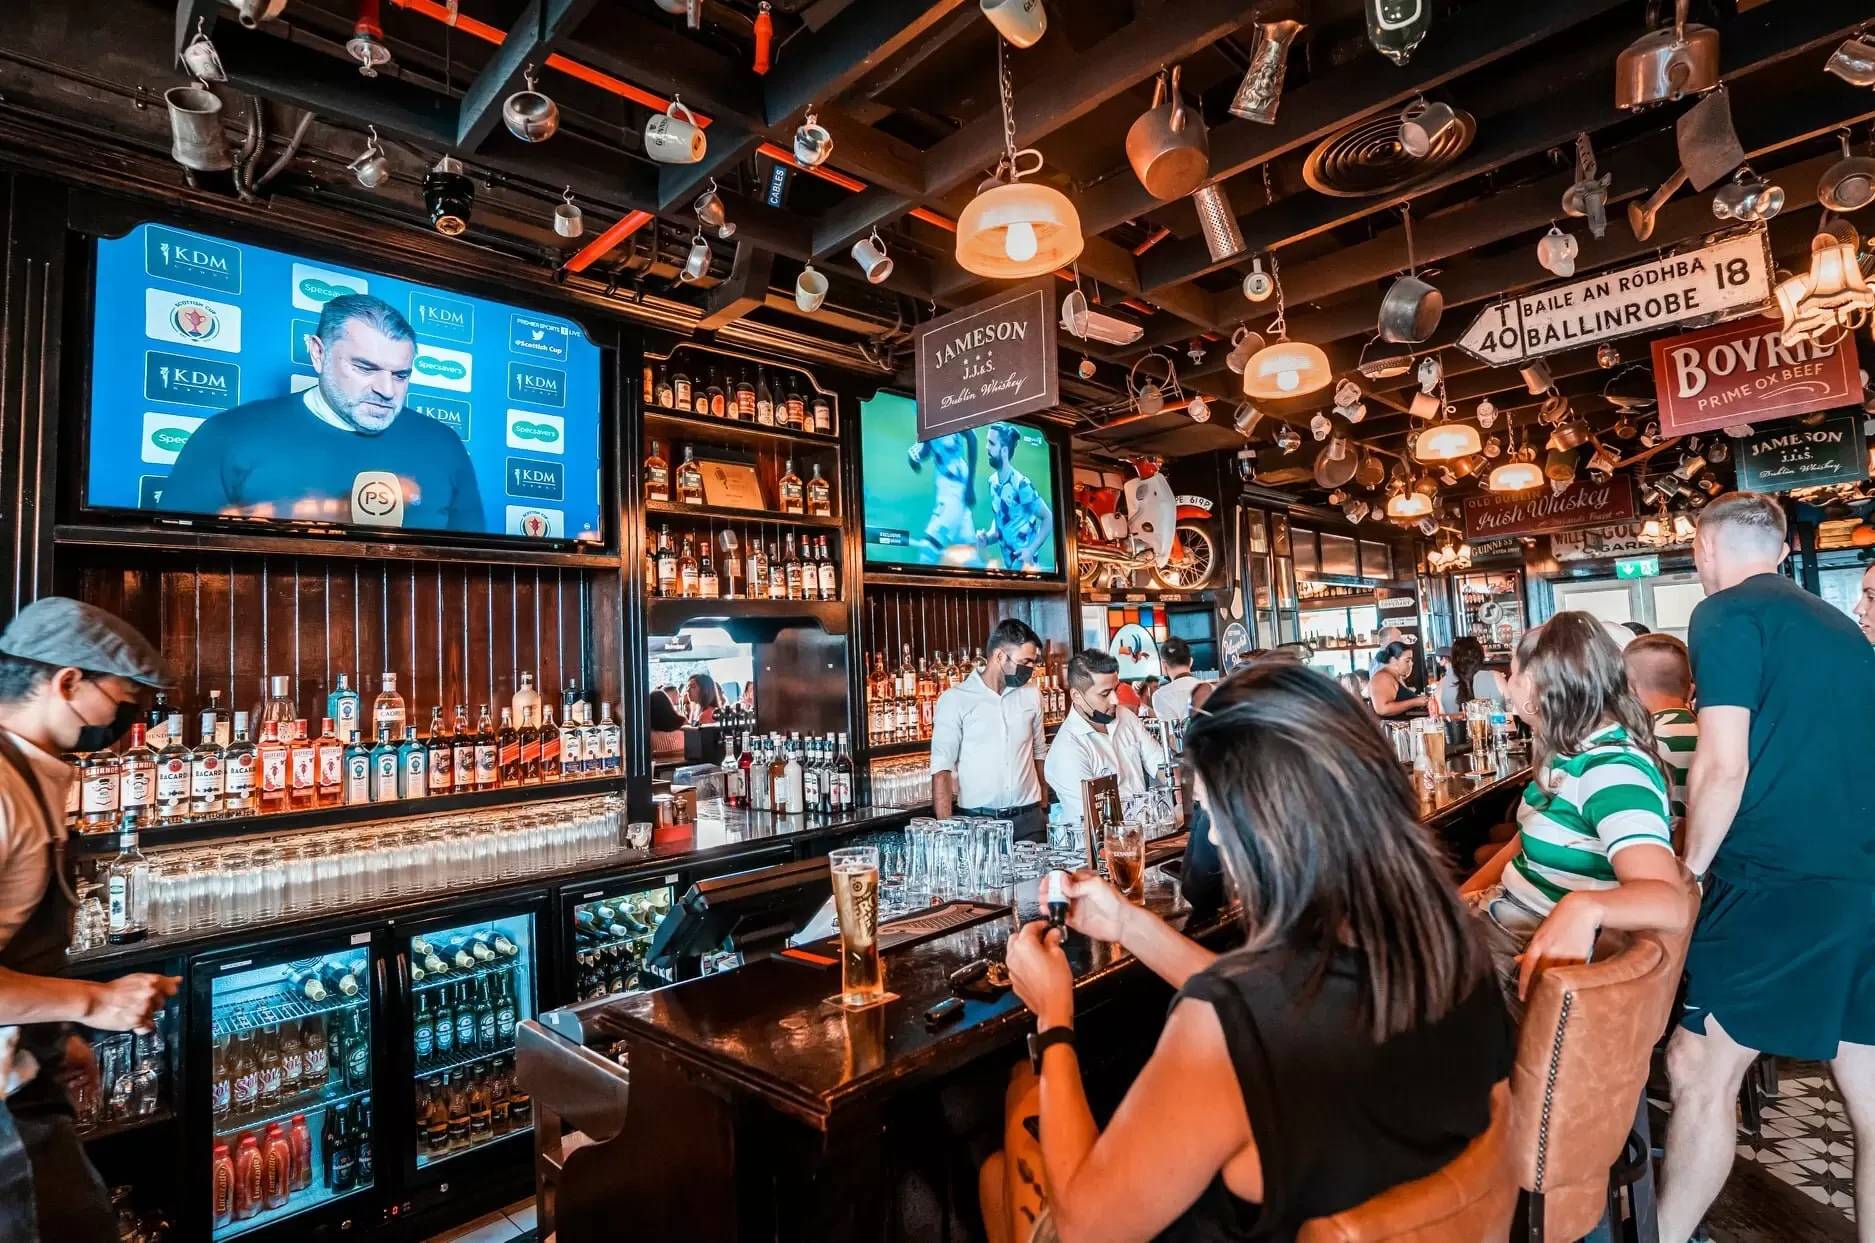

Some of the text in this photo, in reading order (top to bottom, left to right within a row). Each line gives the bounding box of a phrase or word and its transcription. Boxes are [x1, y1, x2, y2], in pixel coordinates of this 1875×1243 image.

[770, 169, 784, 204] CABLES
[175, 246, 228, 270] KDM
[1523, 257, 1750, 317] BAILE AN RÓDHBA 18
[428, 306, 464, 324] KDM
[1494, 304, 1511, 327] T
[1526, 288, 1700, 347] BALLINROBE
[549, 346, 562, 355] Cup
[935, 321, 1028, 369] JAMESON
[1479, 327, 1519, 353] 40
[418, 360, 463, 374] Specsavers
[174, 368, 227, 388] KDM
[525, 374, 557, 390] KDM
[1697, 363, 1825, 411] PRIME OX BEEF
[940, 371, 1029, 409] Dublin Whiskey
[426, 407, 461, 422] KDM
[515, 425, 556, 437] Specsavers
[1751, 431, 1844, 456] JAMESON
[523, 469, 555, 484] KDM
[1759, 459, 1842, 479] Dublin Whiskey
[365, 491, 389, 505] PS
[1476, 504, 1523, 532] Irish
[1527, 487, 1610, 518] Whiskey
[1471, 537, 1514, 557] GUINNESS
